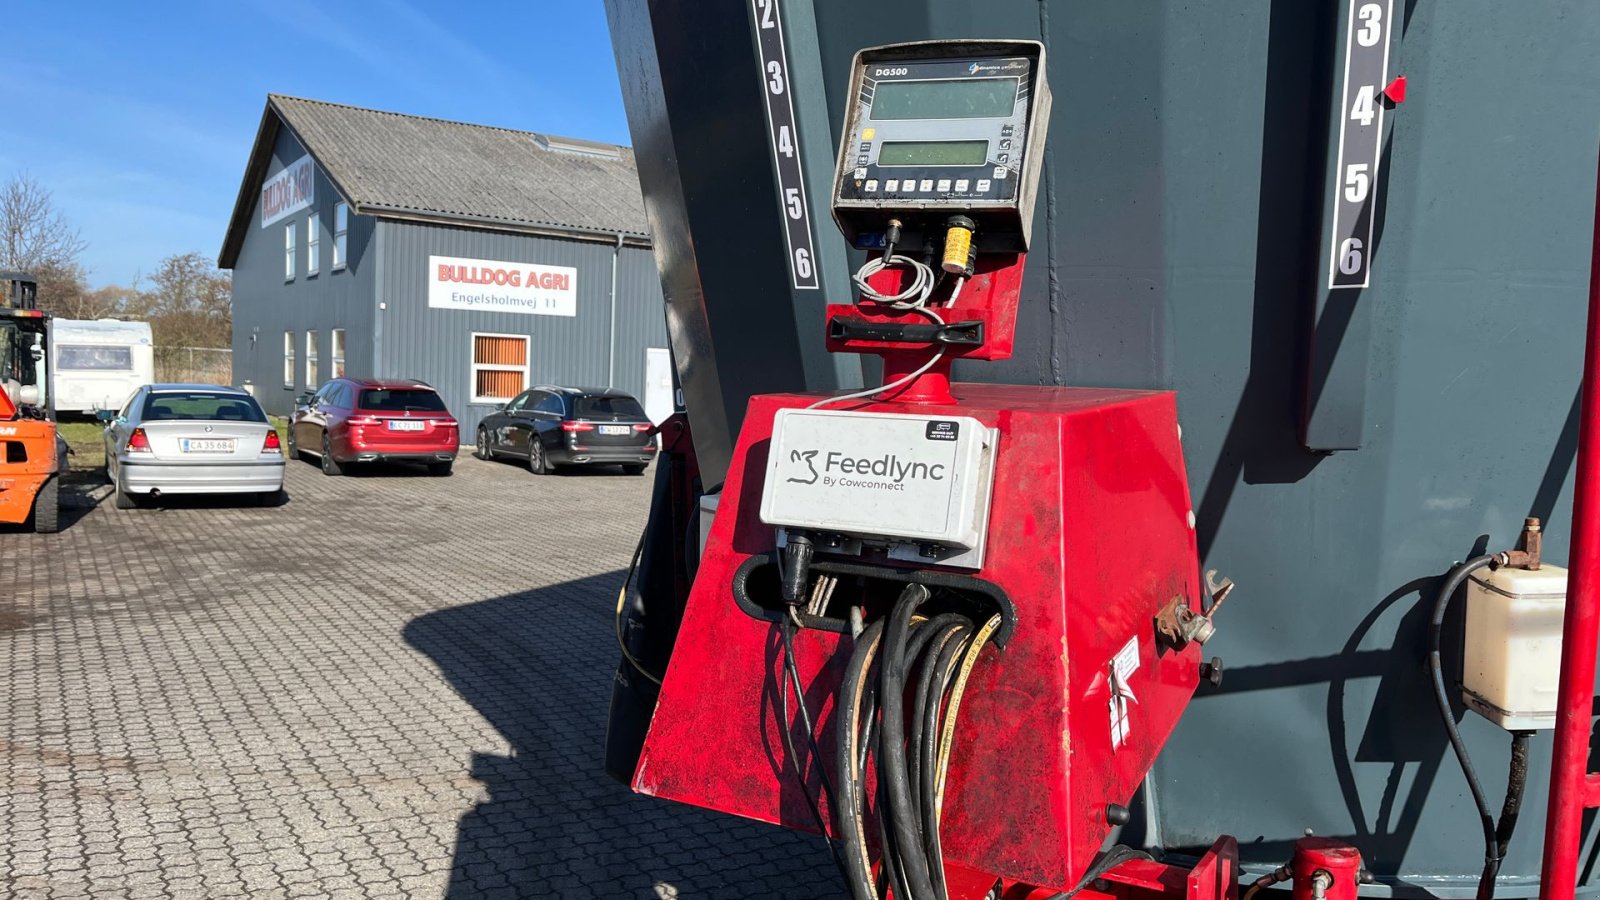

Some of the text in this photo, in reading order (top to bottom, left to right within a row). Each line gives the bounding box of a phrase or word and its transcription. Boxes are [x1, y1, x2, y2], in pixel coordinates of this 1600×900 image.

[758, 0, 775, 29] 2
[1357, 3, 1382, 47] 3
[767, 60, 784, 95] 3
[875, 67, 908, 76] DG500
[1350, 85, 1375, 126] 4
[778, 125, 793, 158] 4
[1344, 163, 1369, 202] 5
[785, 188, 803, 220] 5
[795, 247, 812, 279] 6
[1339, 237, 1363, 274] 6
[438, 264, 569, 291] BULLDOG AGRI
[451, 292, 556, 309] Engelsholmvej 11
[825, 451, 945, 483] Feedlync
[823, 476, 905, 491] By Cowconnect
